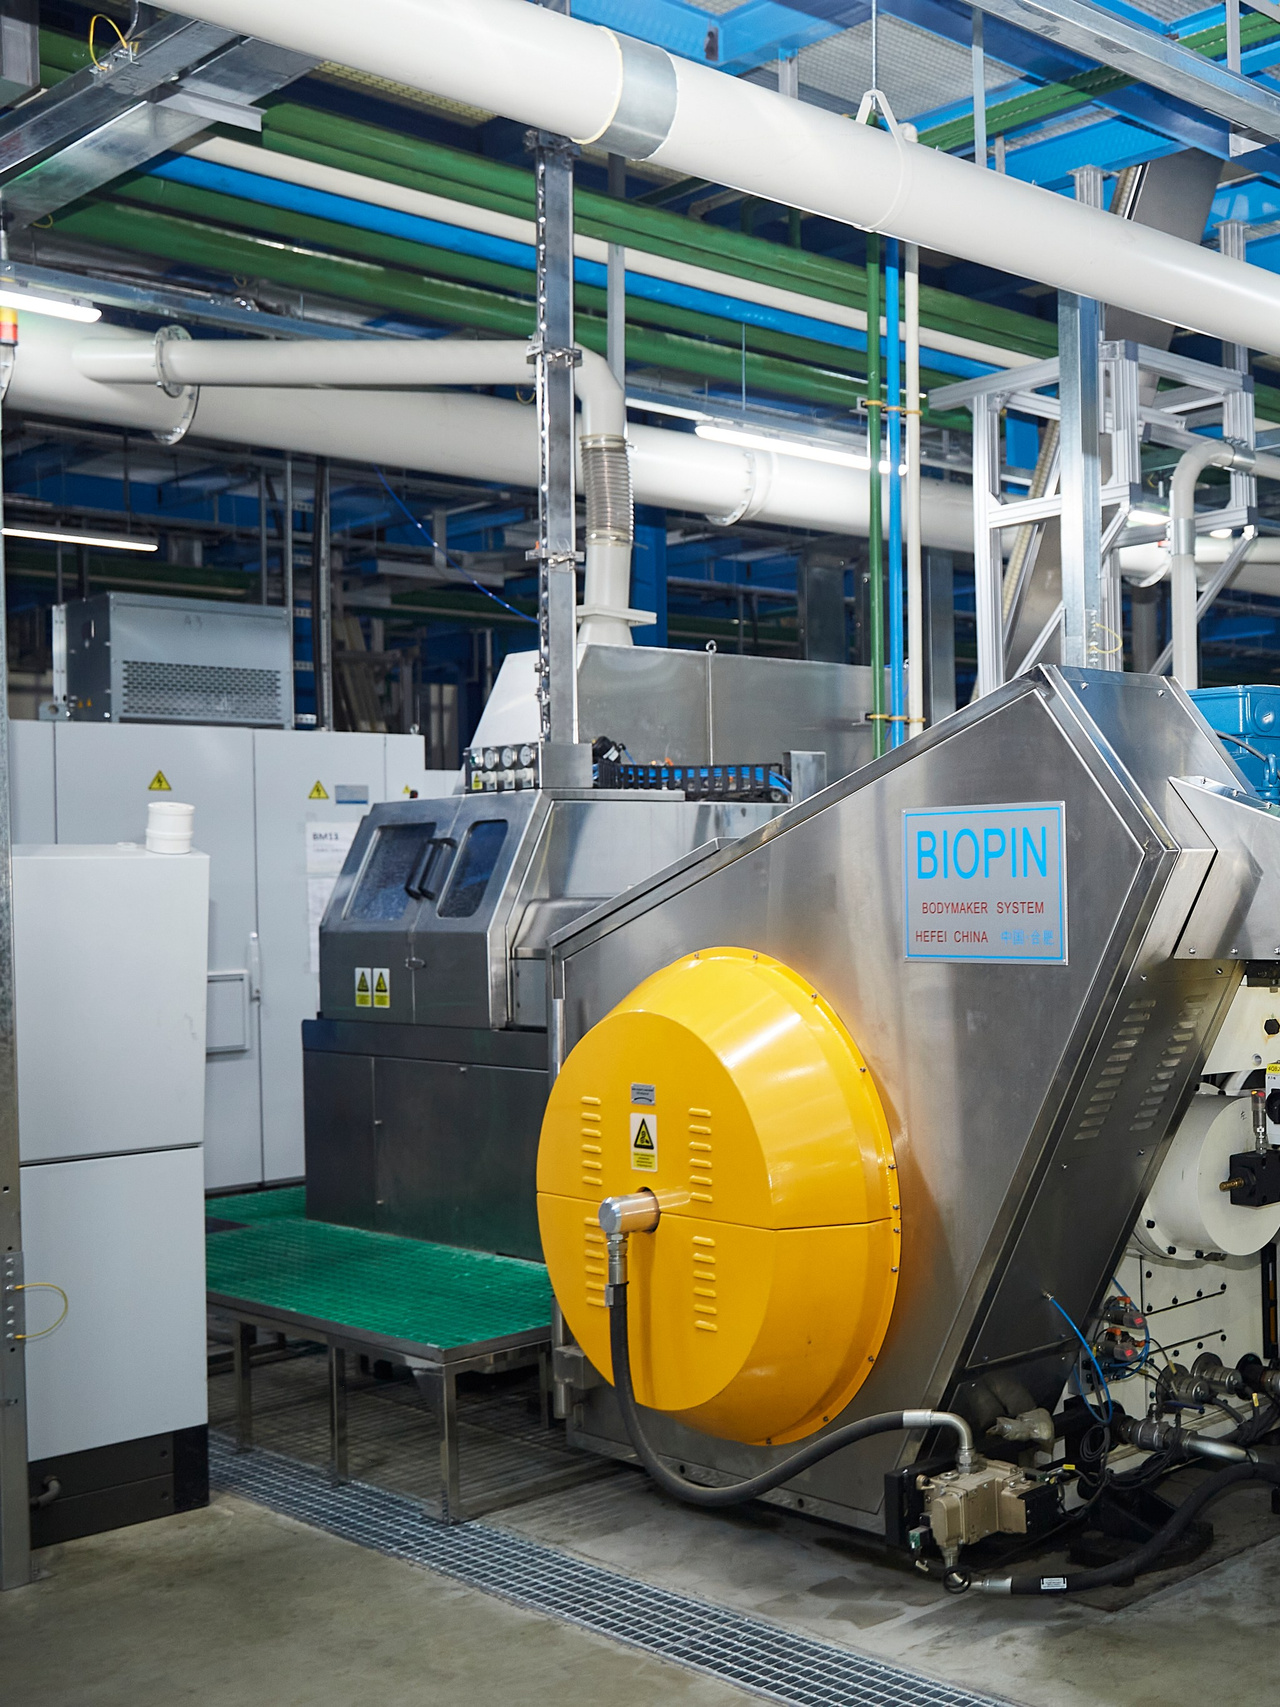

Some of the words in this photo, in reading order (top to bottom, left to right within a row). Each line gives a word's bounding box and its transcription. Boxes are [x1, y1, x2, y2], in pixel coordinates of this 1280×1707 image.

[917, 826, 1047, 879] BIOPIN
[921, 901, 989, 914] BODYMAKER
[996, 901, 1045, 914] SYSTEM
[915, 930, 948, 943] HEFEI
[953, 930, 989, 943] CHINA
